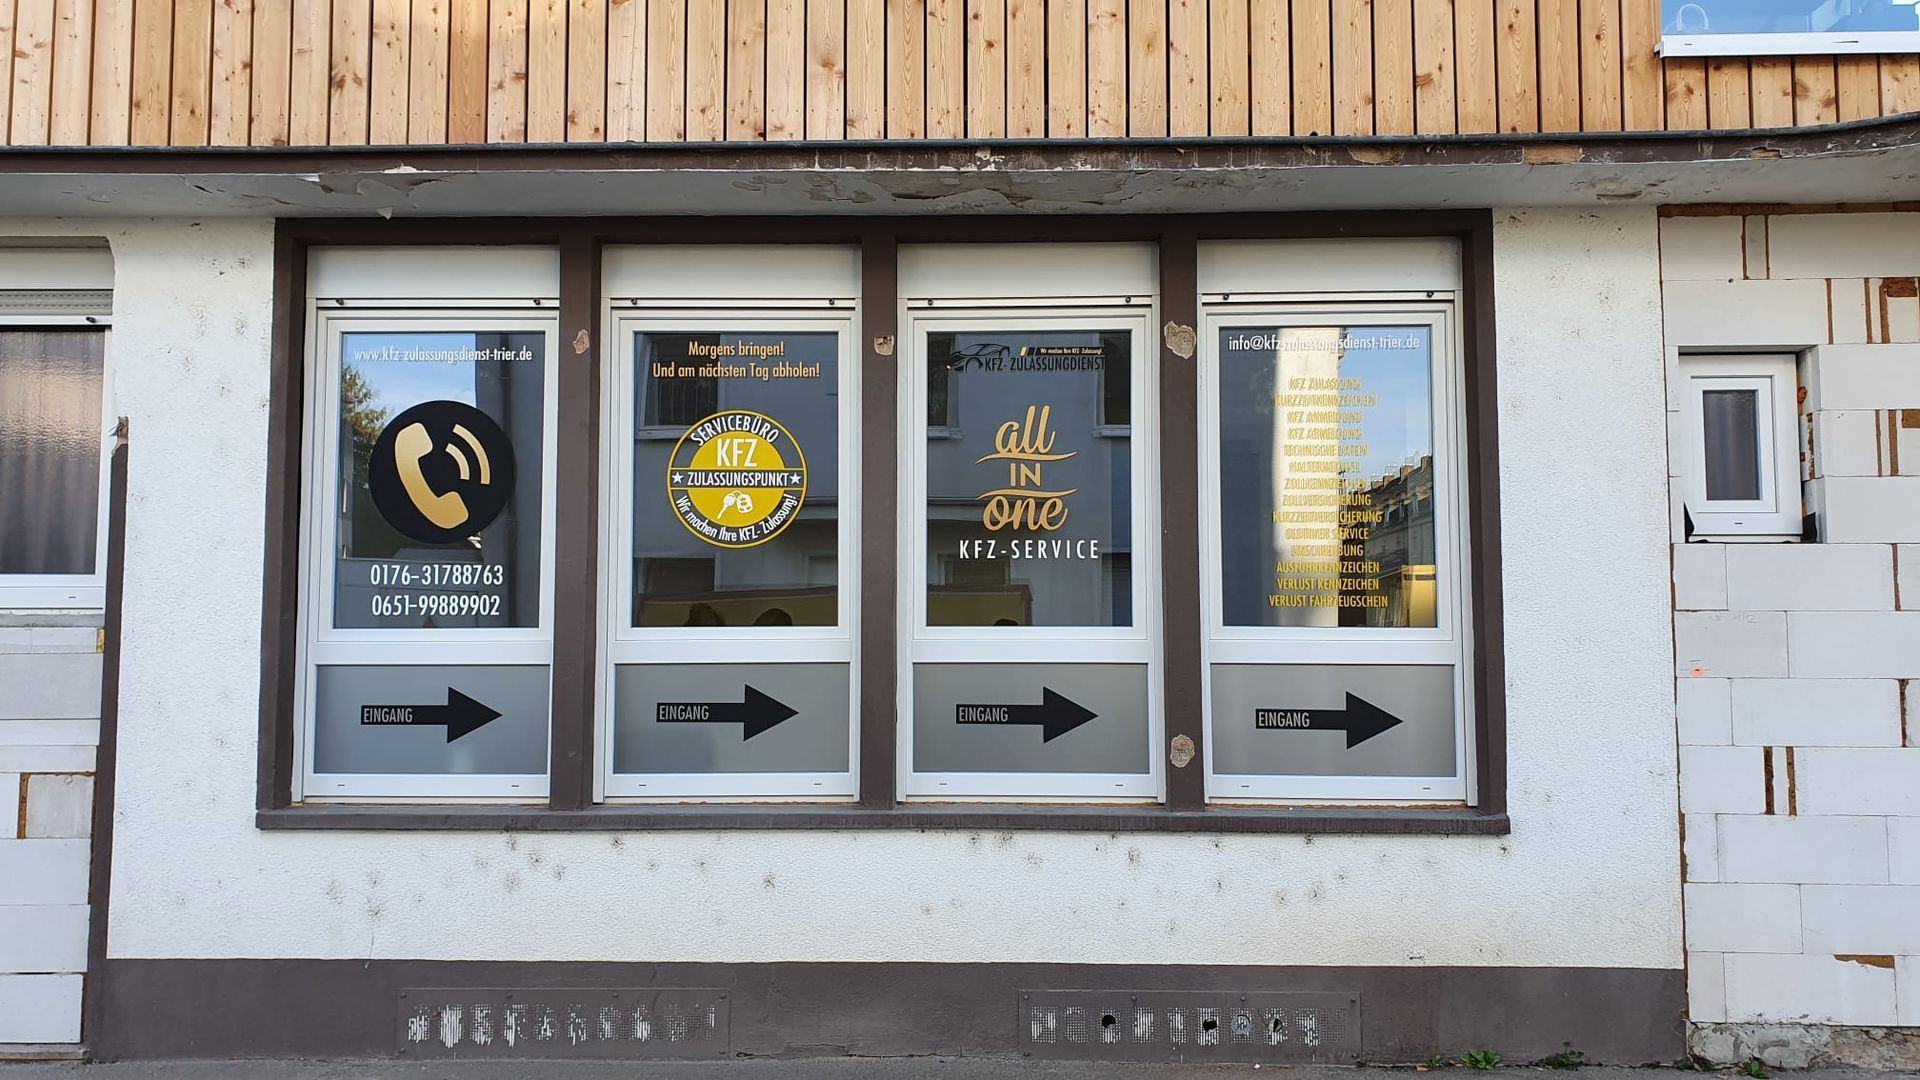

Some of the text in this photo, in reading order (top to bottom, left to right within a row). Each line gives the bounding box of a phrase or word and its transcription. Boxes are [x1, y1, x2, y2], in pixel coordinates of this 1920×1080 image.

[355, 346, 532, 364] www.kfz-zulassungsdienst-trier.de
[688, 340, 784, 359] Morgens bringen!
[653, 361, 820, 380] Und am nächsten Tag abholen!
[1010, 357, 1105, 371] ZULASSUNGDIENST
[691, 414, 779, 446] SERVICEBÜRO
[995, 405, 1056, 454] all
[717, 438, 758, 467] KFZ
[687, 472, 789, 487] ZULASSUNGSPUNKT
[1010, 463, 1041, 487] IN
[675, 494, 691, 513] Wir
[686, 512, 718, 538] machen
[719, 526, 737, 542] Ihre
[758, 493, 798, 533] Zulassung!
[983, 495, 1068, 531] one
[1331, 528, 1369, 540] SERVICE
[959, 539, 1099, 559] KFZ-SERVICE
[370, 564, 504, 585] 0176-31788763
[1276, 561, 1380, 574] AUSFUHRKENNZEICHEN
[1277, 578, 1379, 591] VERLUST KENNZEICHEN
[371, 595, 501, 616] 0651-99889902
[1269, 595, 1388, 608] VERLUST FAHRZEUGSCHEIN
[363, 708, 413, 723] EINGANG
[659, 705, 709, 720] EINGANG
[959, 707, 1009, 722] EINGANG
[1258, 712, 1310, 727] EINGANG
